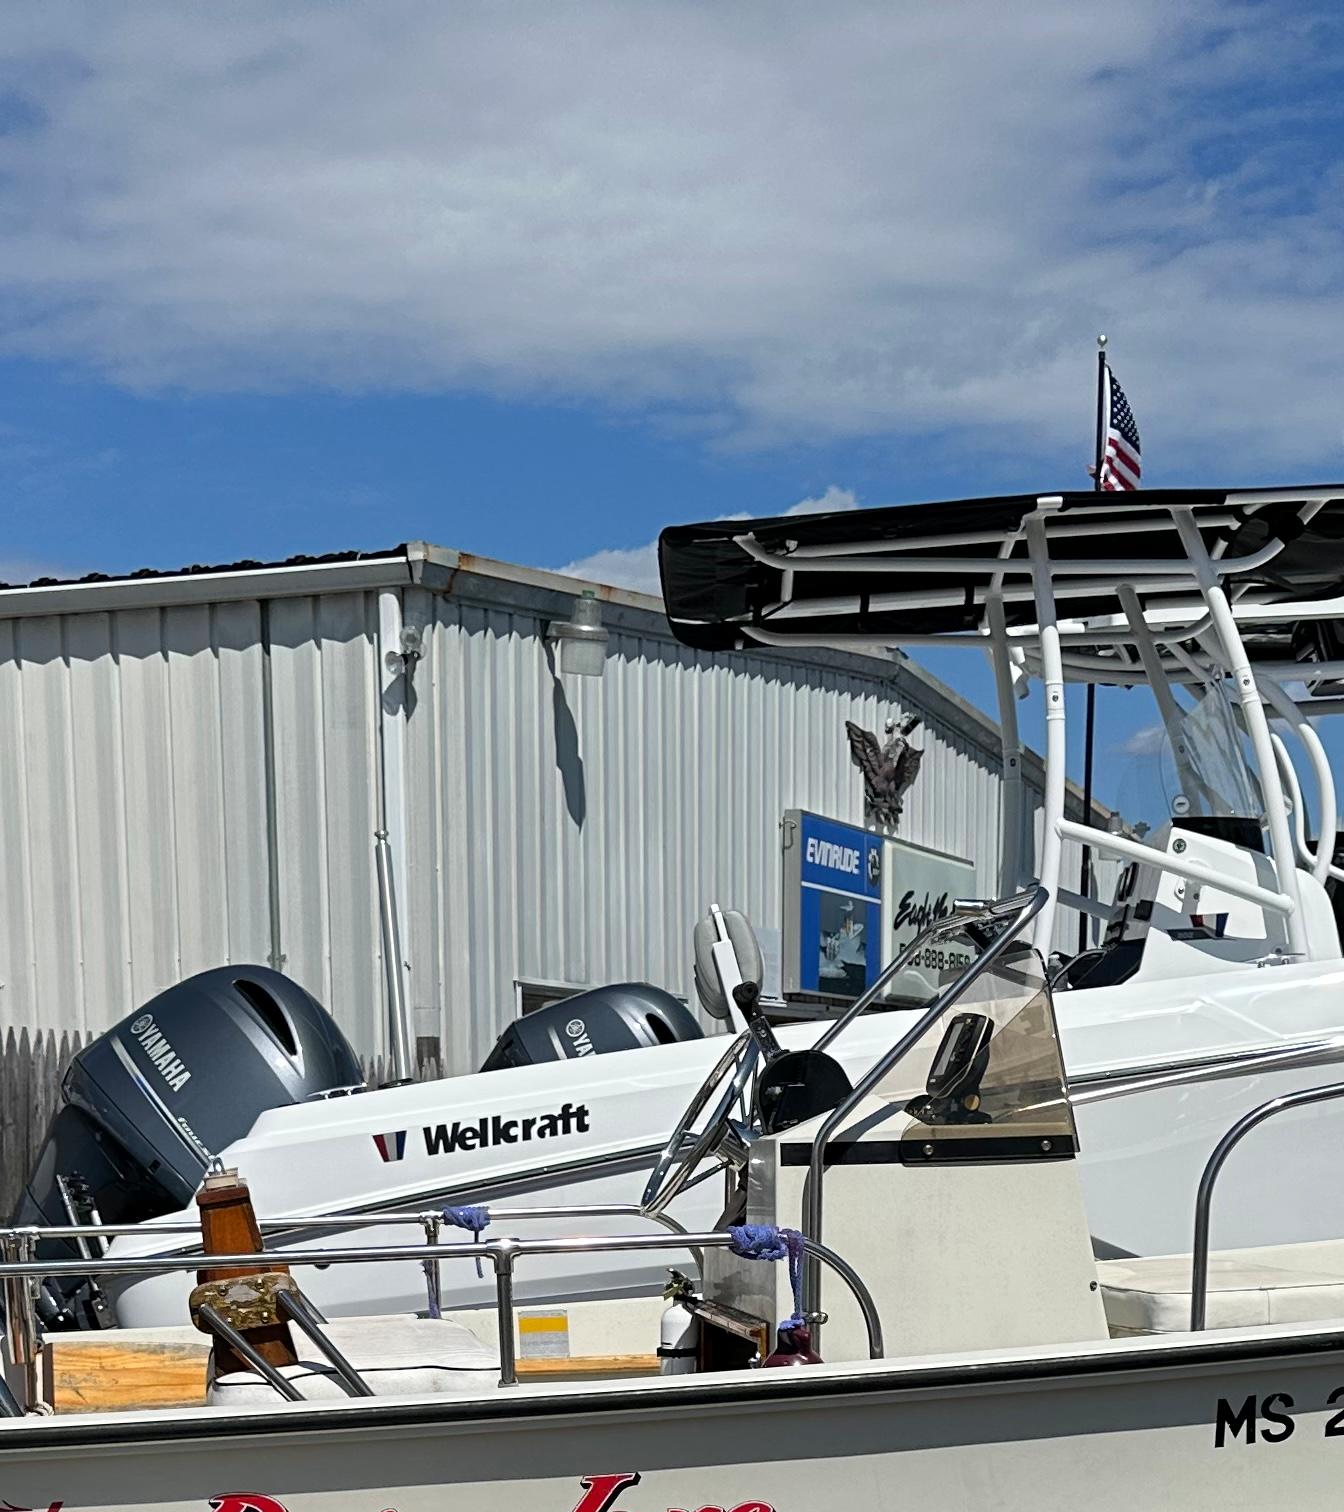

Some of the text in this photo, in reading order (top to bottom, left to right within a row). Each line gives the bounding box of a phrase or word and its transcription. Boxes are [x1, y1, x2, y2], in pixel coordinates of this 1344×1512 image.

[806, 837, 860, 875] EVINRUDE
[137, 1023, 192, 1092] YAMAHA
[422, 1103, 590, 1156] Wellcraft
[1214, 1391, 1295, 1448] MS
